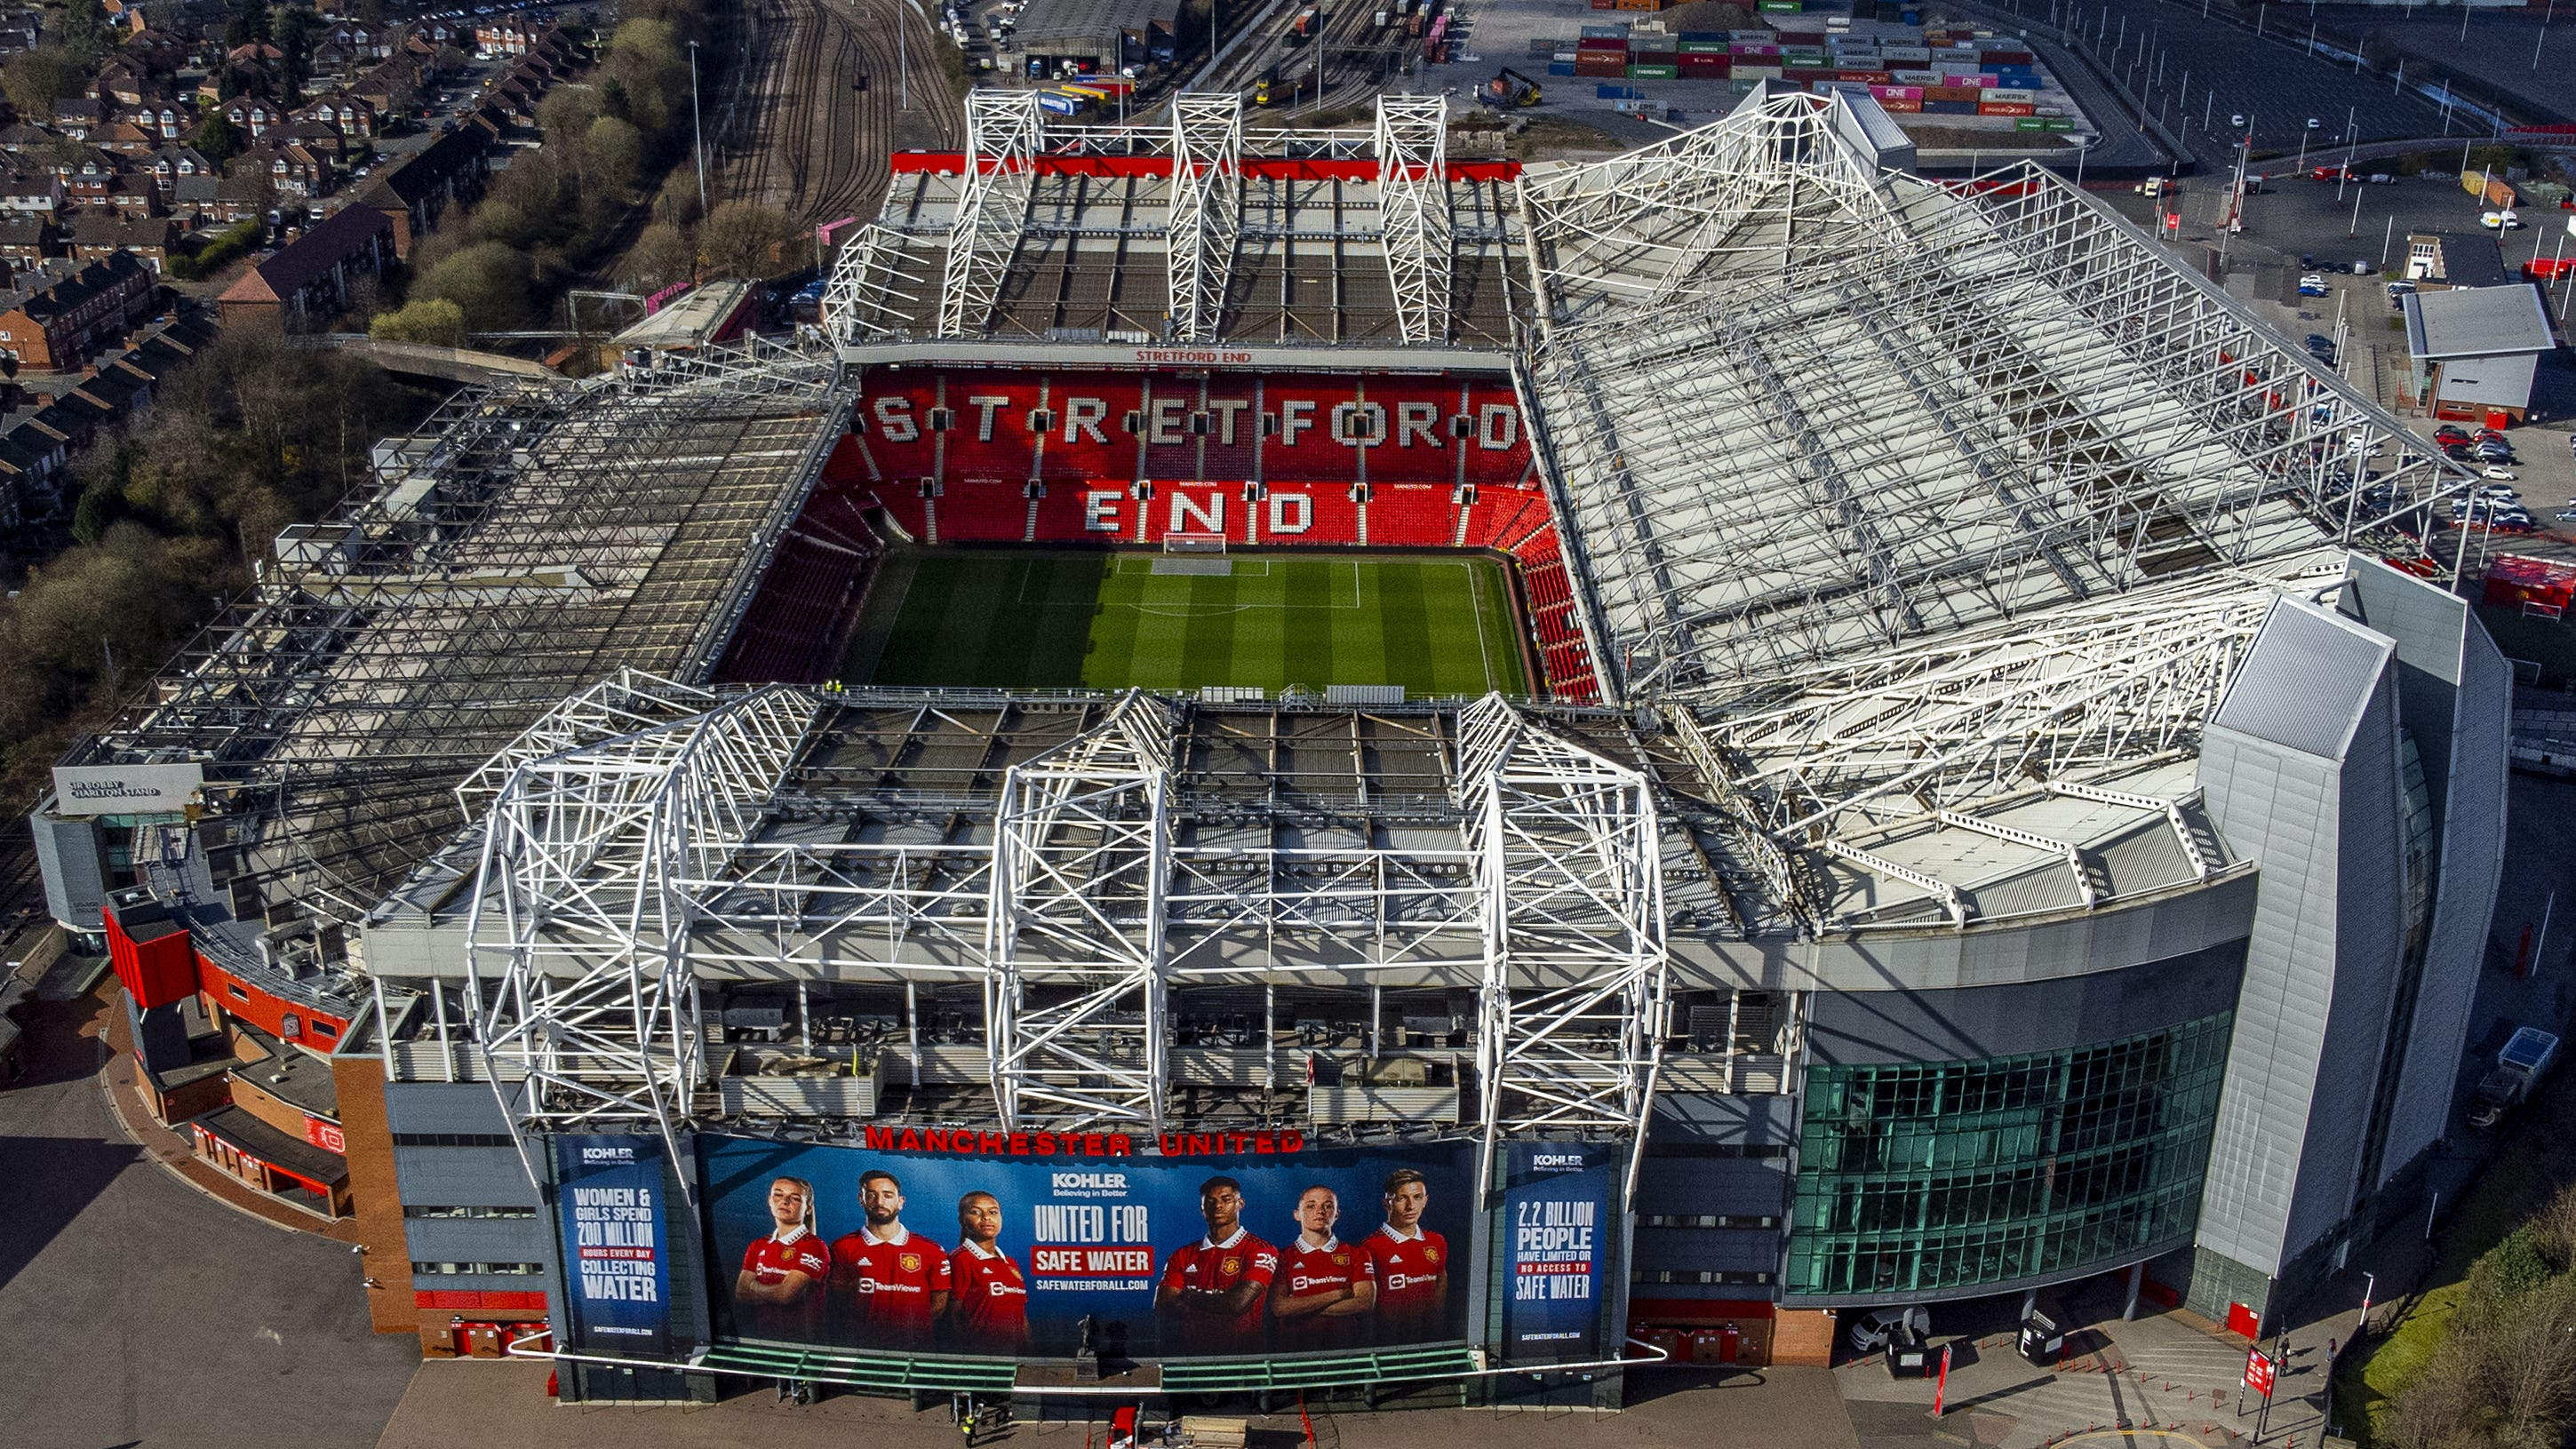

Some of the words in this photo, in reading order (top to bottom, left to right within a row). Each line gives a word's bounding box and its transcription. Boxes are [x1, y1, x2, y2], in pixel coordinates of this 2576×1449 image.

[1136, 350, 1217, 362] STRETFORD
[1222, 352, 1251, 363] END
[873, 395, 1518, 451] STRETFORD
[1085, 490, 1314, 535] END
[69, 781, 84, 790] SIR
[85, 780, 122, 790] BOBBY
[124, 787, 159, 798] STAND
[865, 1123, 1131, 1158] MANCHESTER
[1159, 1127, 1304, 1158] UNITED
[583, 1147, 634, 1159] KOHLER
[1534, 1154, 1583, 1166] KOHLER
[1052, 1173, 1128, 1189] KOHLER
[574, 1188, 634, 1206] WOMEN
[639, 1188, 650, 1207] &
[1053, 1189, 1091, 1198] Believing
[576, 1206, 610, 1222] GIRLS
[613, 1206, 652, 1222] SPEND
[1518, 1200, 1542, 1227] 2.2
[1545, 1200, 1595, 1227] BILLION
[1034, 1205, 1105, 1243] UNITED
[1111, 1205, 1149, 1243] FOR
[577, 1222, 602, 1246] 200
[604, 1222, 654, 1247] MILLION
[1517, 1227, 1592, 1251] PEOPLE
[583, 1248, 609, 1258] HOURS
[610, 1248, 634, 1258] EVERY
[636, 1249, 650, 1259] DAY
[1036, 1250, 1082, 1271] SAFE
[1087, 1250, 1149, 1271] WATER
[1517, 1250, 1540, 1262] HAVE
[1542, 1250, 1577, 1262] LIMITED
[1578, 1250, 1591, 1262] OR
[580, 1260, 656, 1277] COLLECTING
[1536, 1263, 1571, 1272] ACCESS
[1575, 1263, 1587, 1272] TO
[582, 1274, 658, 1302] WATER
[1036, 1279, 1149, 1291] SAFEWATERFORALL.COM
[1515, 1275, 1547, 1301] SAFE
[1550, 1274, 1591, 1300] WATER
